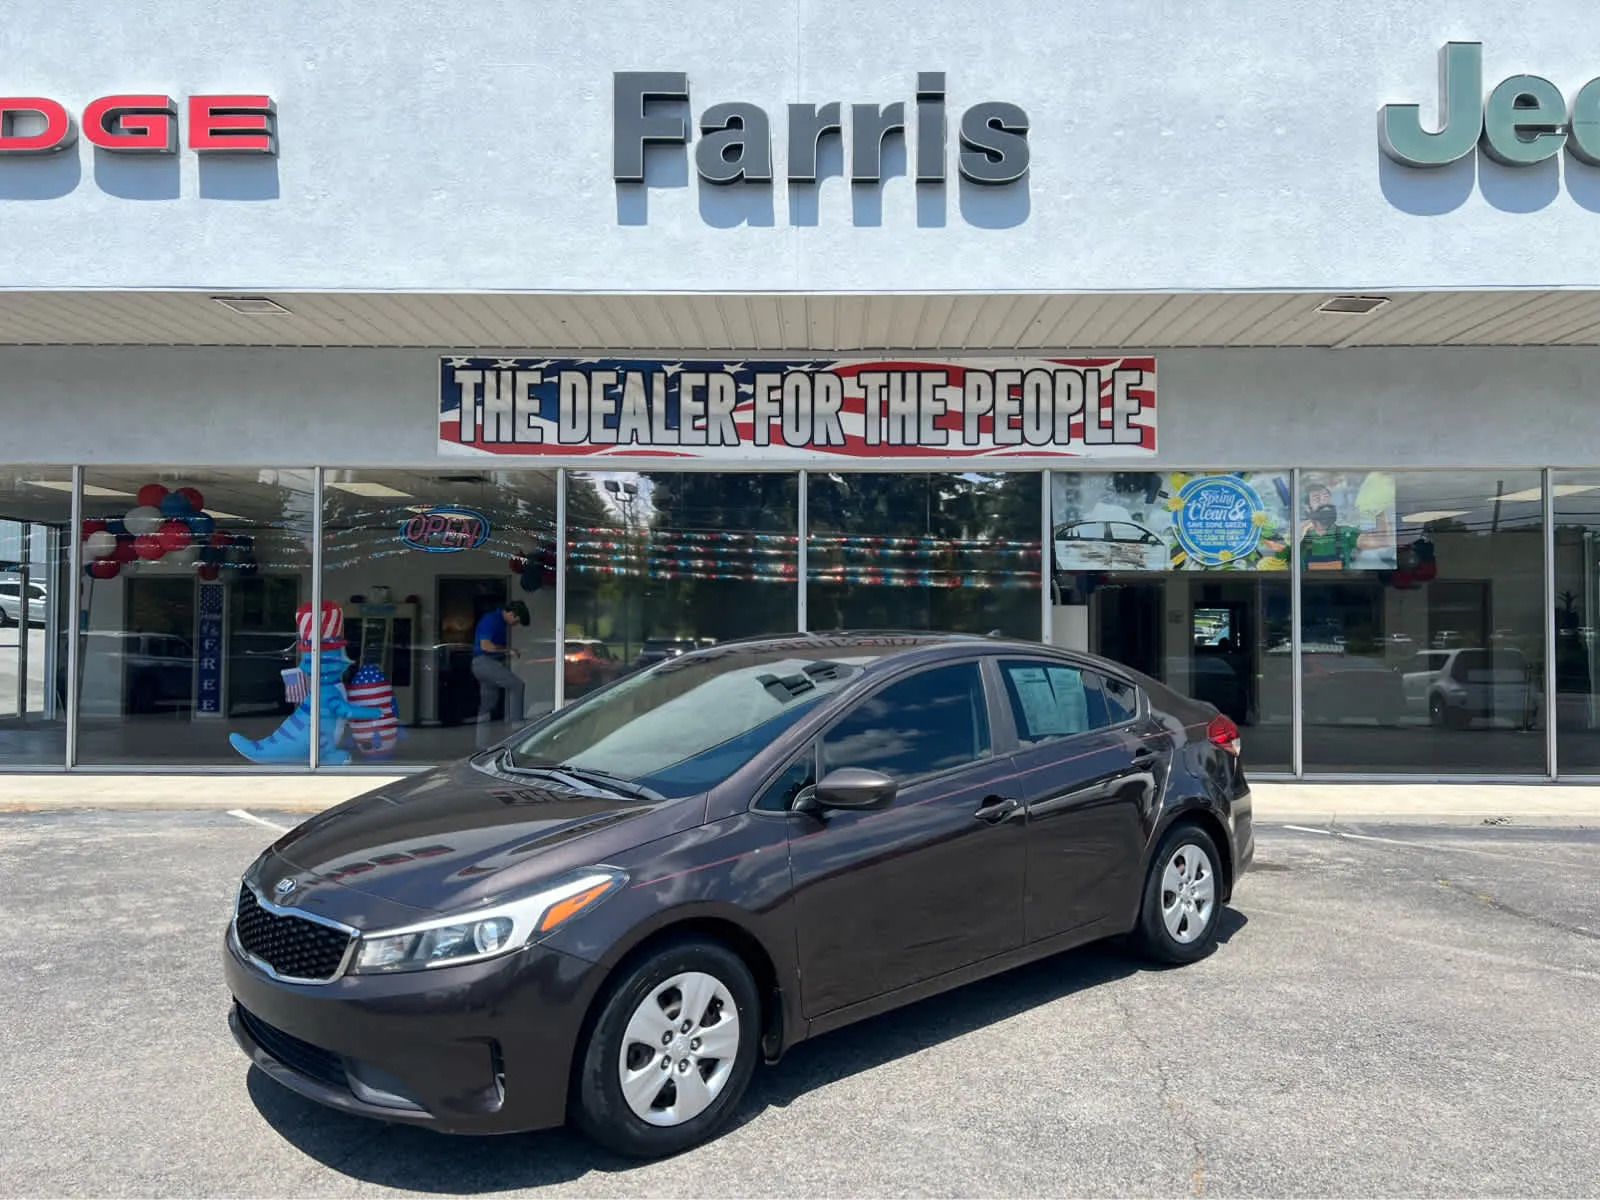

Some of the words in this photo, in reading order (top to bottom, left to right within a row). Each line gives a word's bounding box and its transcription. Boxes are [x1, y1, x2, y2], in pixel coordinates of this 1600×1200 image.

[613, 71, 1029, 184] Farris
[453, 369, 544, 445] THE
[557, 370, 741, 447] DEALER
[753, 369, 847, 447] FOR
[857, 369, 949, 446] THE
[963, 368, 1144, 446] PEOPLE
[1187, 499, 1227, 521] Clean
[1228, 498, 1246, 521] &
[1200, 488, 1236, 509] Spring
[407, 513, 480, 549] OPEN
[202, 638, 217, 712] FREE
